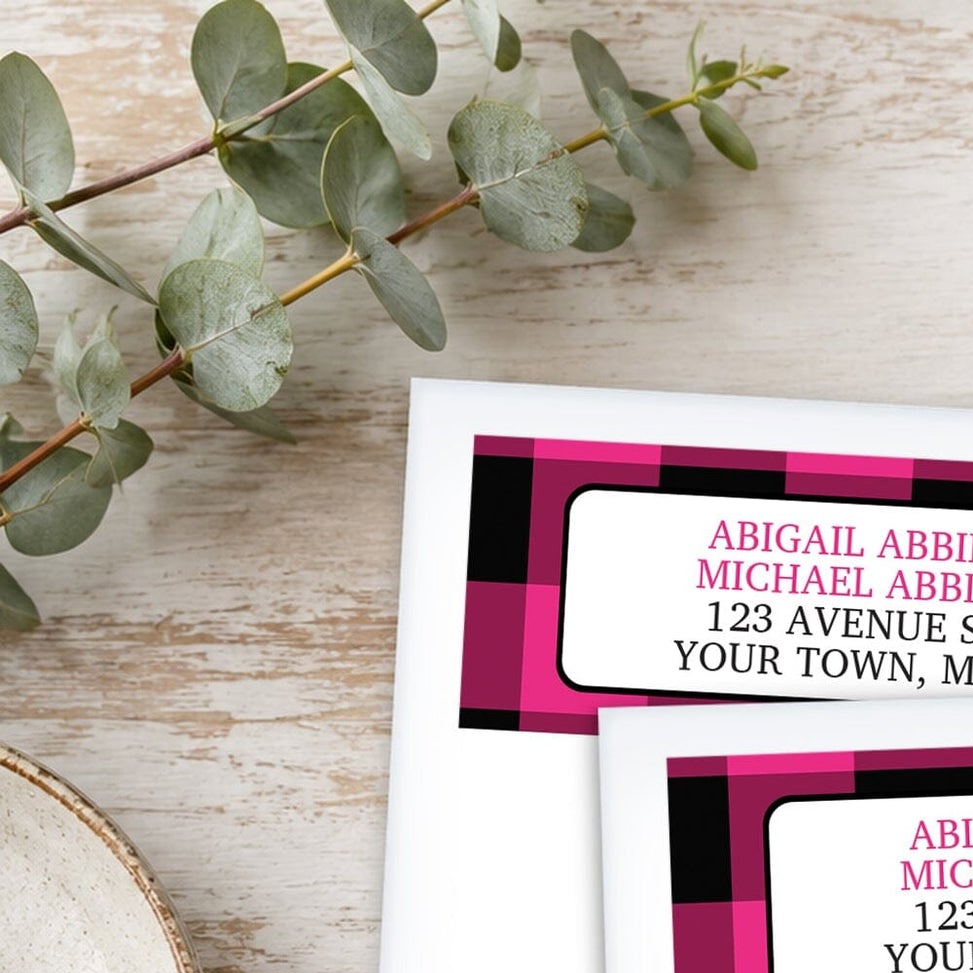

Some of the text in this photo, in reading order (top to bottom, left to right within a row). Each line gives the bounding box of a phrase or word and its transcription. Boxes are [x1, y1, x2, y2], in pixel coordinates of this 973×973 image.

[708, 520, 864, 557] ABIGAIL
[696, 559, 873, 598] MICHAEL
[708, 601, 773, 632] 123
[786, 606, 946, 643] AVENUE
[674, 640, 782, 675] YOUR
[797, 647, 926, 689] TOWN,
